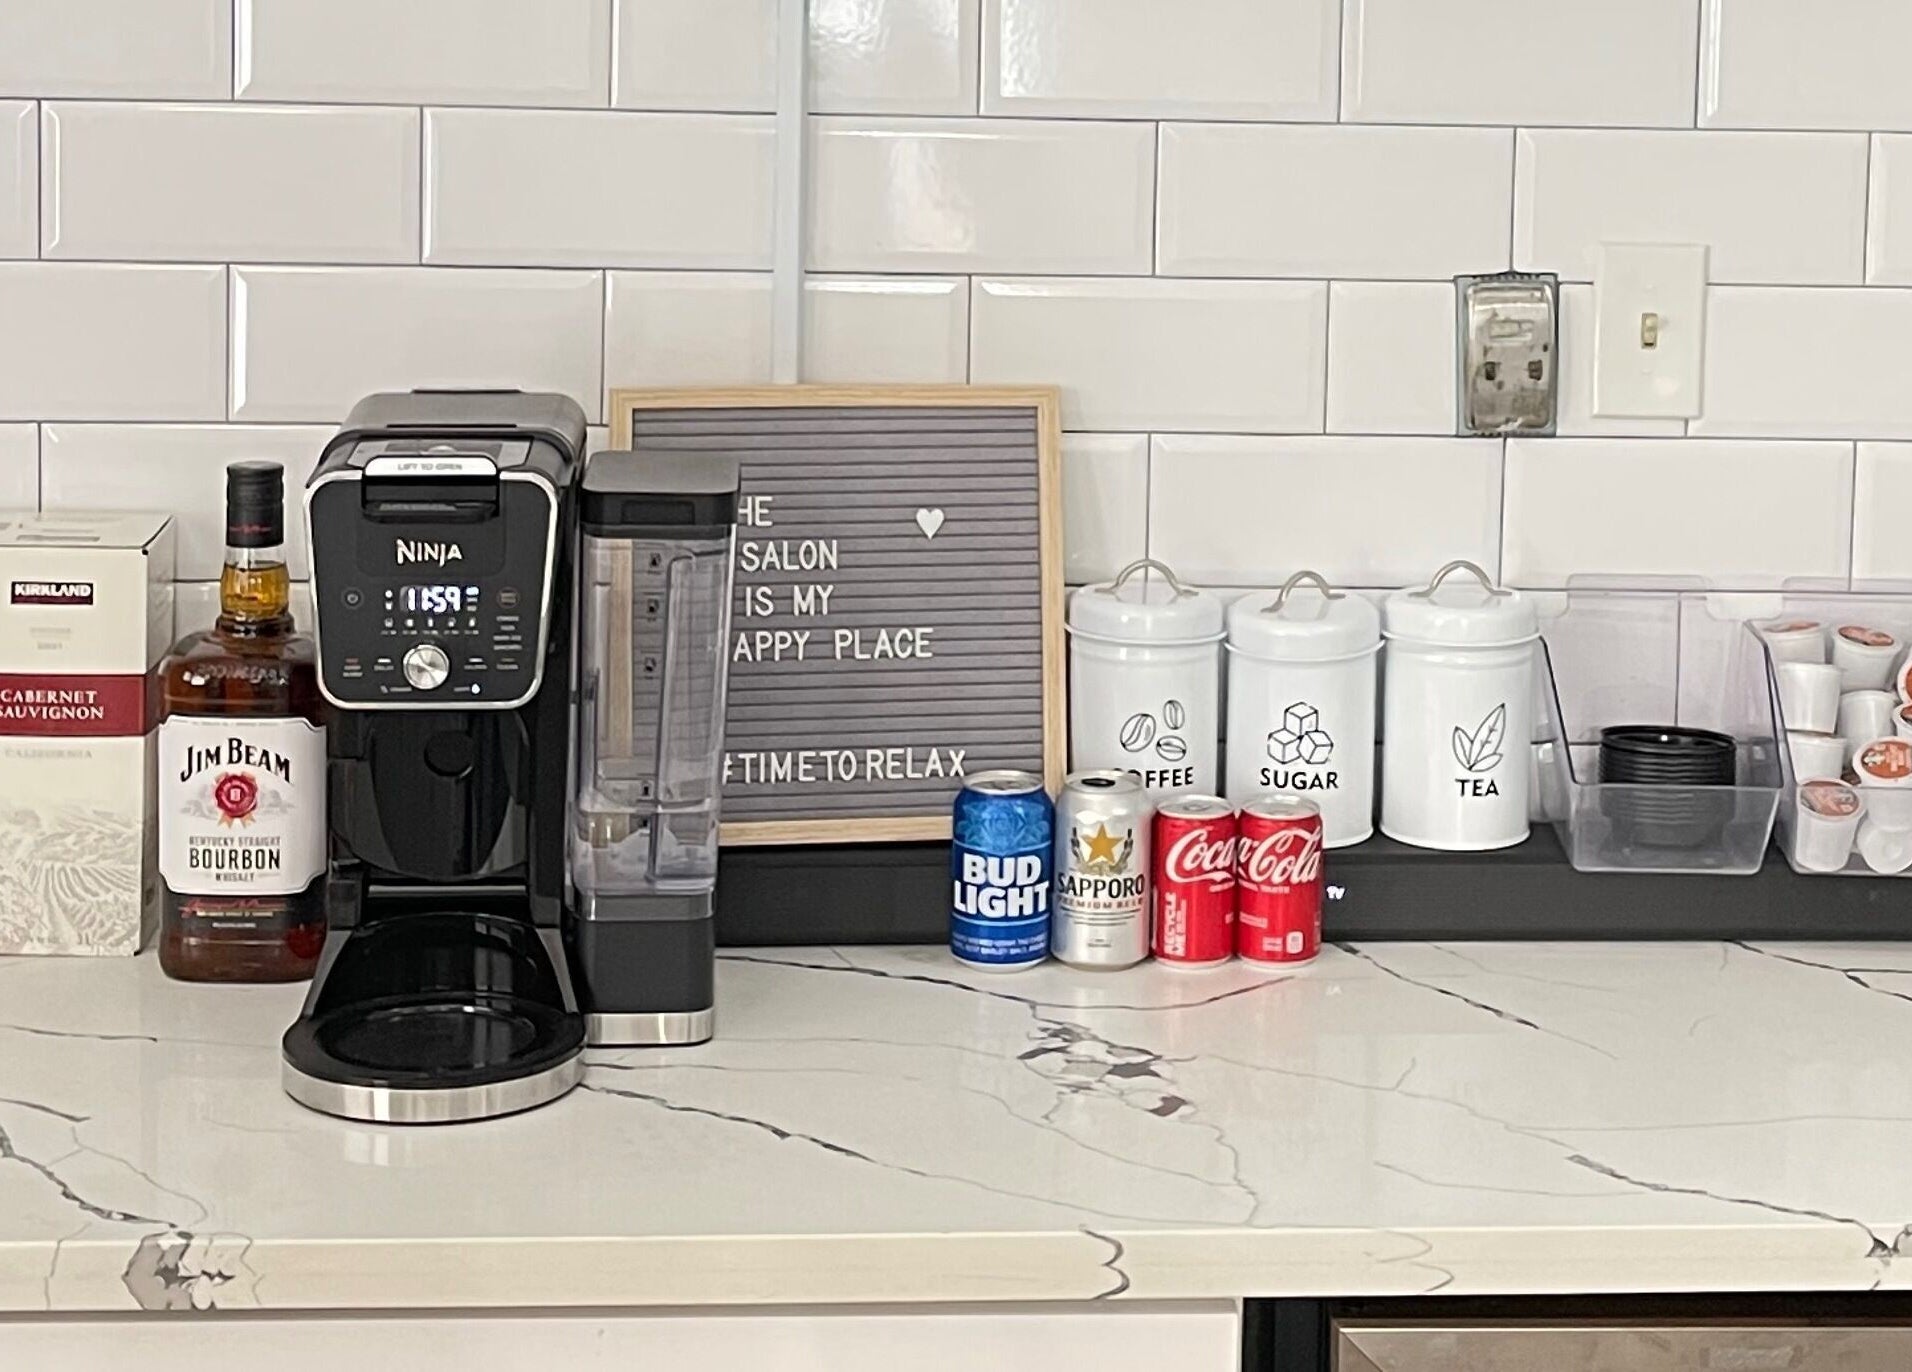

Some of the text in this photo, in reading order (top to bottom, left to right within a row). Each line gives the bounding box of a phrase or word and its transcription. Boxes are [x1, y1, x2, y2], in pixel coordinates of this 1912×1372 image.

[738, 496, 773, 526] HE
[396, 538, 463, 567] NINJA
[740, 539, 838, 572] SALON
[14, 583, 93, 597] KIRKLAND
[745, 584, 834, 617] IS MY
[733, 627, 934, 662] APPY PLACE
[0, 688, 98, 704] CABERNET
[180, 737, 291, 784] JIM BEAM
[1113, 766, 1194, 789] FFEE
[1260, 767, 1339, 790] SUGAR
[1454, 778, 1500, 797] TEA
[189, 847, 280, 870] BOURBON
[963, 853, 1042, 887] BUD
[953, 880, 1050, 919] LIGHT
[1058, 871, 1145, 899] SAPPORO
